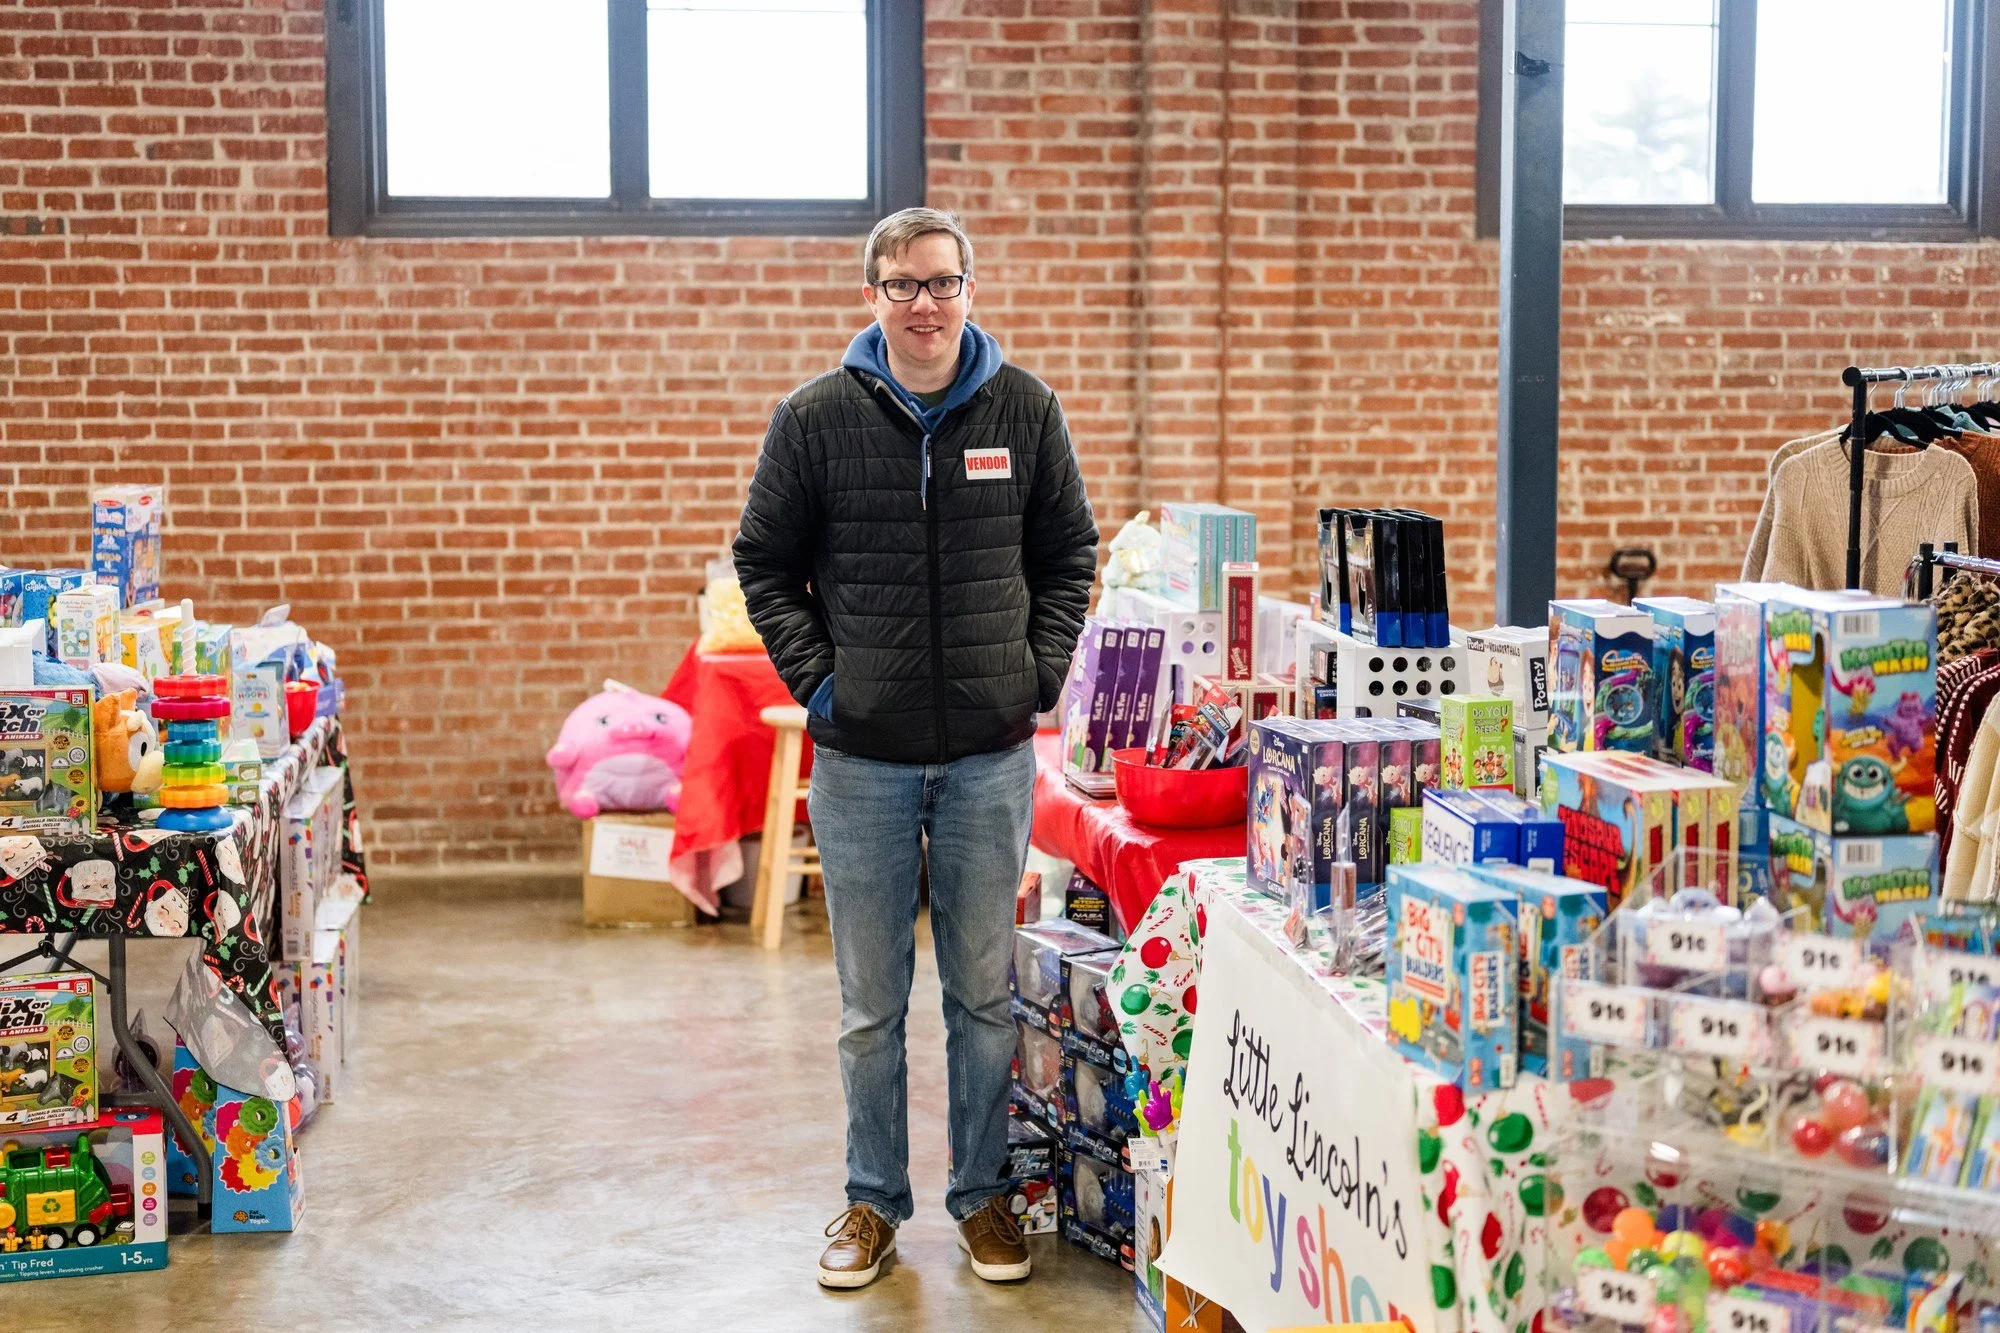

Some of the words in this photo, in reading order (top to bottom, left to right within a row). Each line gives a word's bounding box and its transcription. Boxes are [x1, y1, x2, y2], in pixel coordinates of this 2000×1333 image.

[966, 455, 1008, 473] VENDOR
[1468, 639, 1484, 651] Poetry
[1872, 656, 1929, 676] MASH
[1533, 661, 1548, 708] Poetry
[28, 709, 45, 718] or
[1486, 704, 1509, 718] YOU
[1263, 746, 1296, 774] LORCANA
[1, 818, 14, 827] 4
[1323, 817, 1332, 860] LORCANA
[1359, 817, 1368, 860] LORCANA
[1875, 885, 1930, 905] MASH
[1407, 901, 1430, 932] BIG
[1405, 956, 1445, 984] BUILDERS
[31, 1001, 49, 1010] or
[1472, 993, 1485, 1021] BIG
[9, 1026, 44, 1035] ANIMALS
[5, 1112, 19, 1122] 4
[27, 1110, 51, 1118] ANIMALS
[1223, 1008, 1284, 1133] Little
[1287, 1072, 1407, 1260] Lincoln's
[1227, 1117, 1287, 1293] toy
[11, 1259, 27, 1271] Tip
[29, 1258, 54, 1268] Fred
[20, 1270, 40, 1278] Tipping
